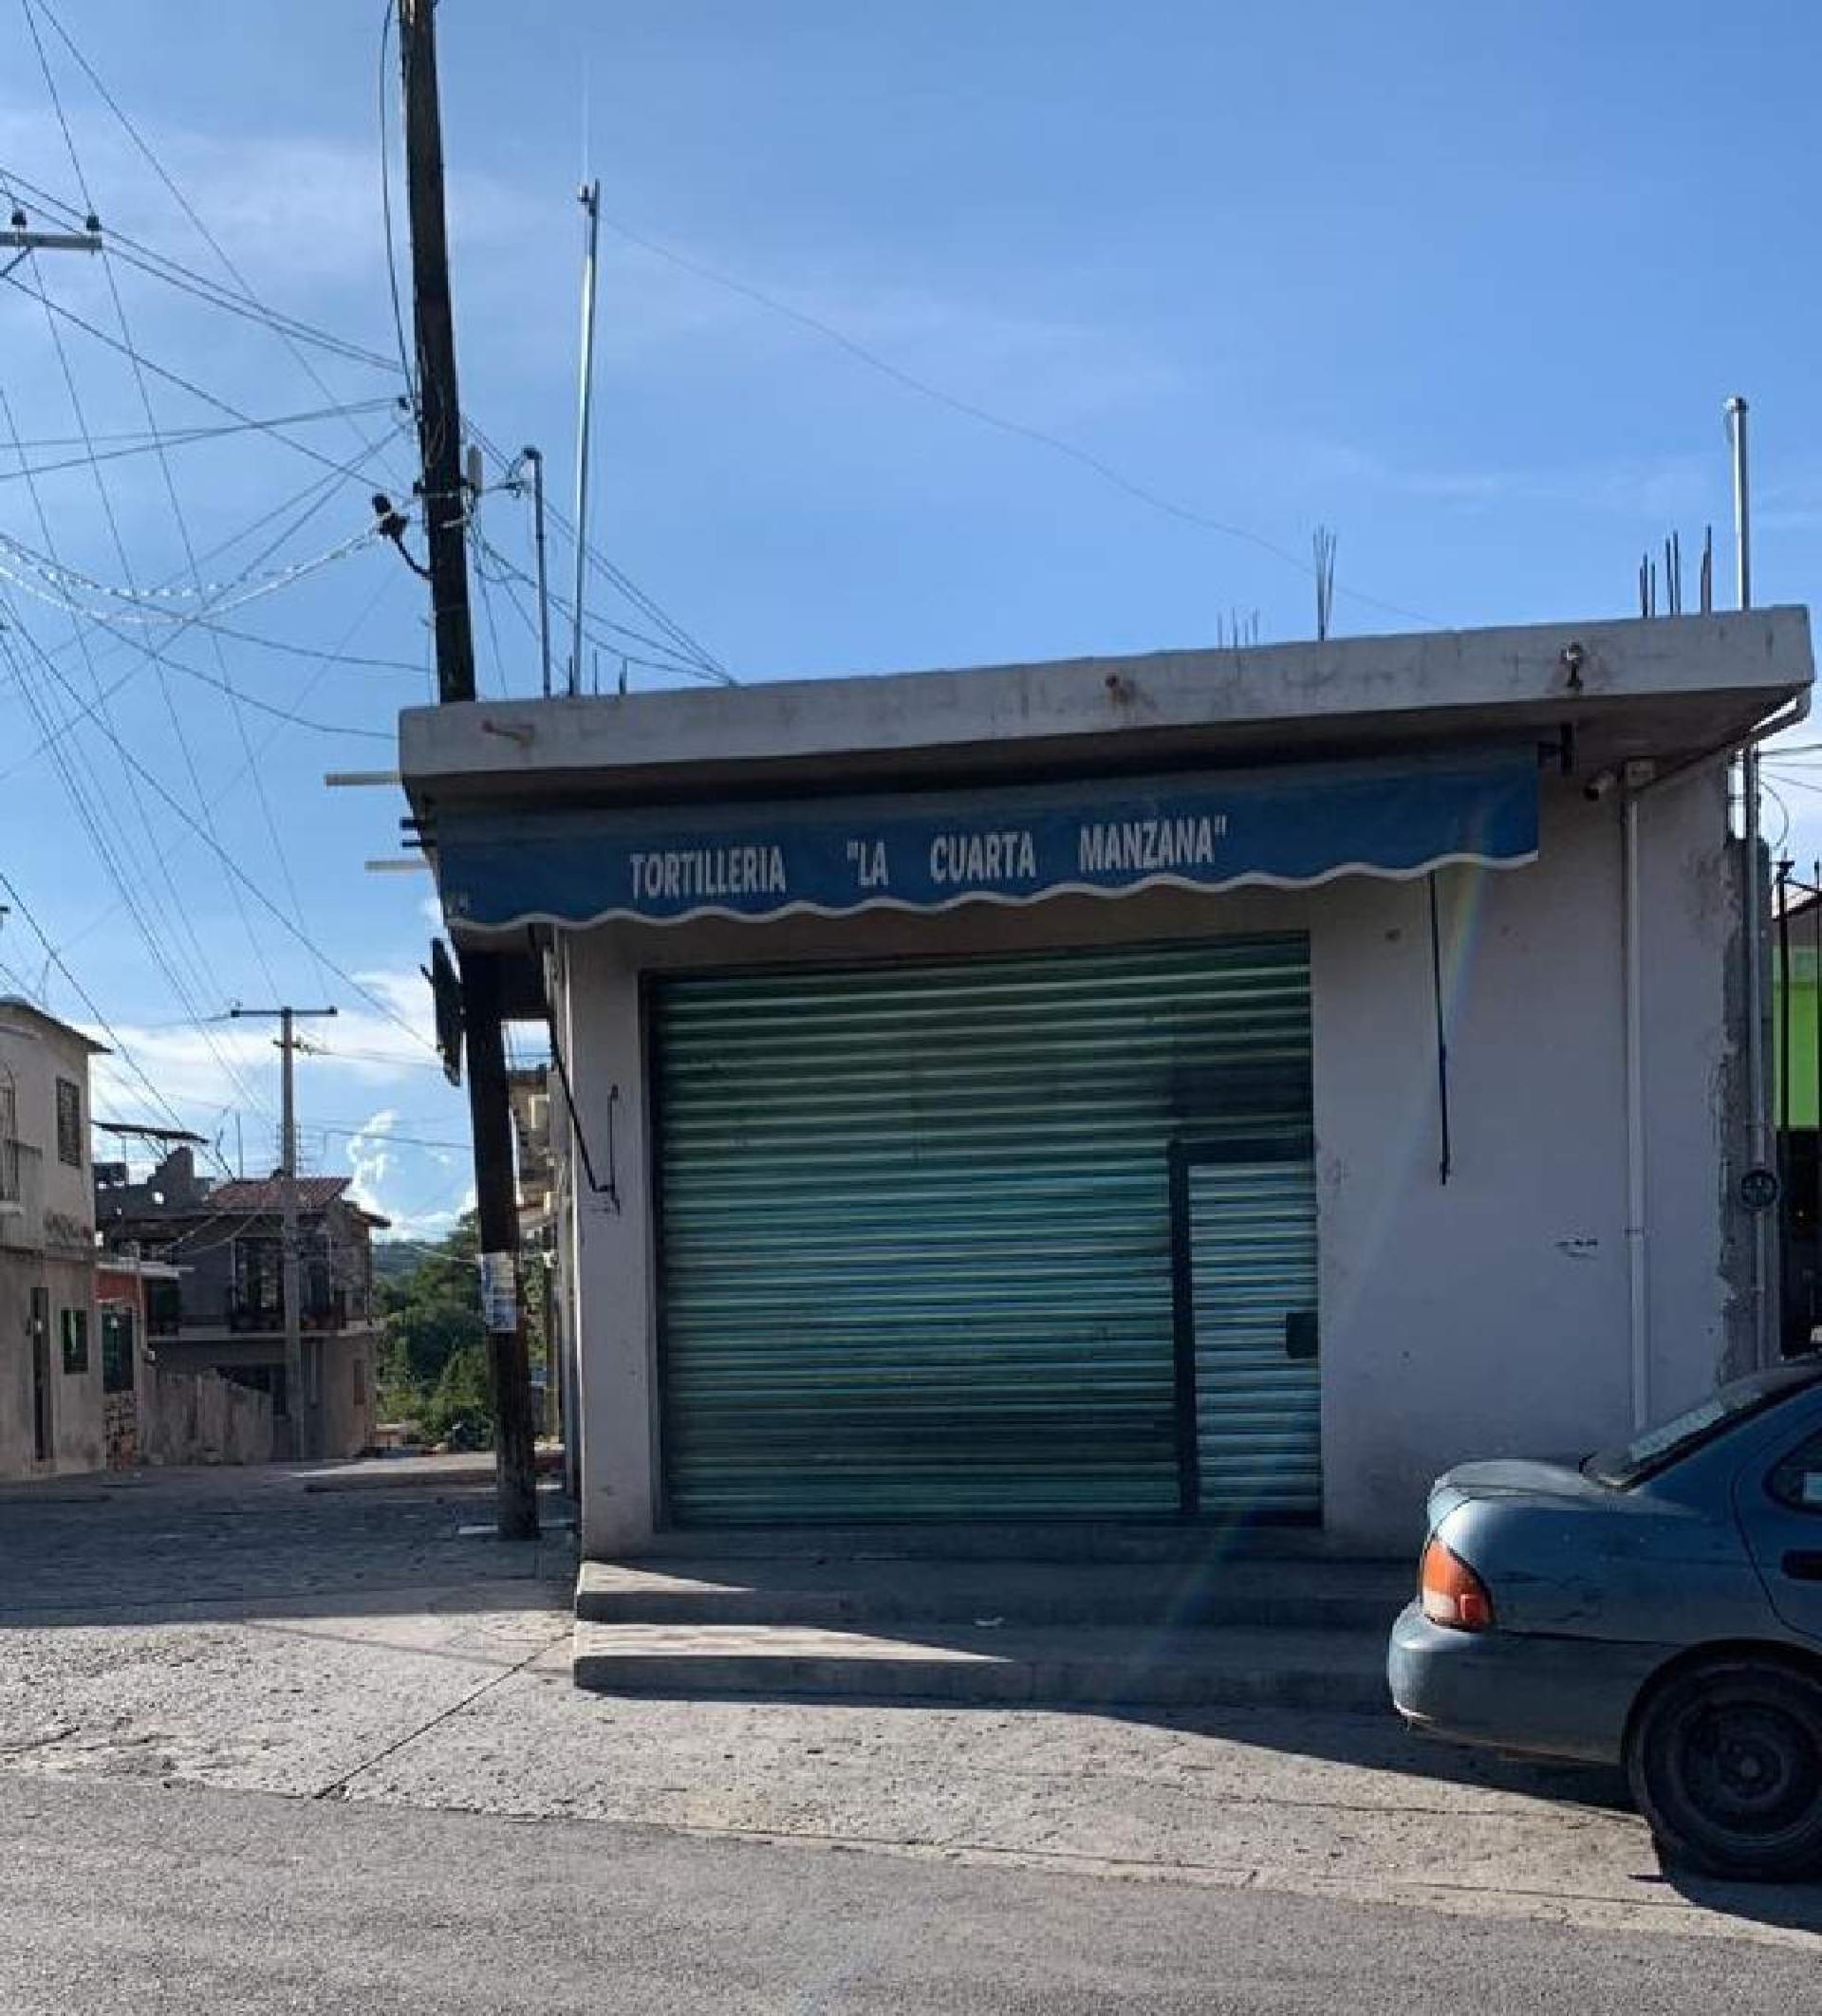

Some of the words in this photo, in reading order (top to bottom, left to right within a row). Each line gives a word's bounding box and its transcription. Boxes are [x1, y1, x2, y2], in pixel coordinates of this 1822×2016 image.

[630, 845, 787, 899] TORTILLERIA
[846, 839, 889, 887] "LA
[930, 831, 1037, 883] CUARTA
[1079, 815, 1228, 872] MANZANA"
